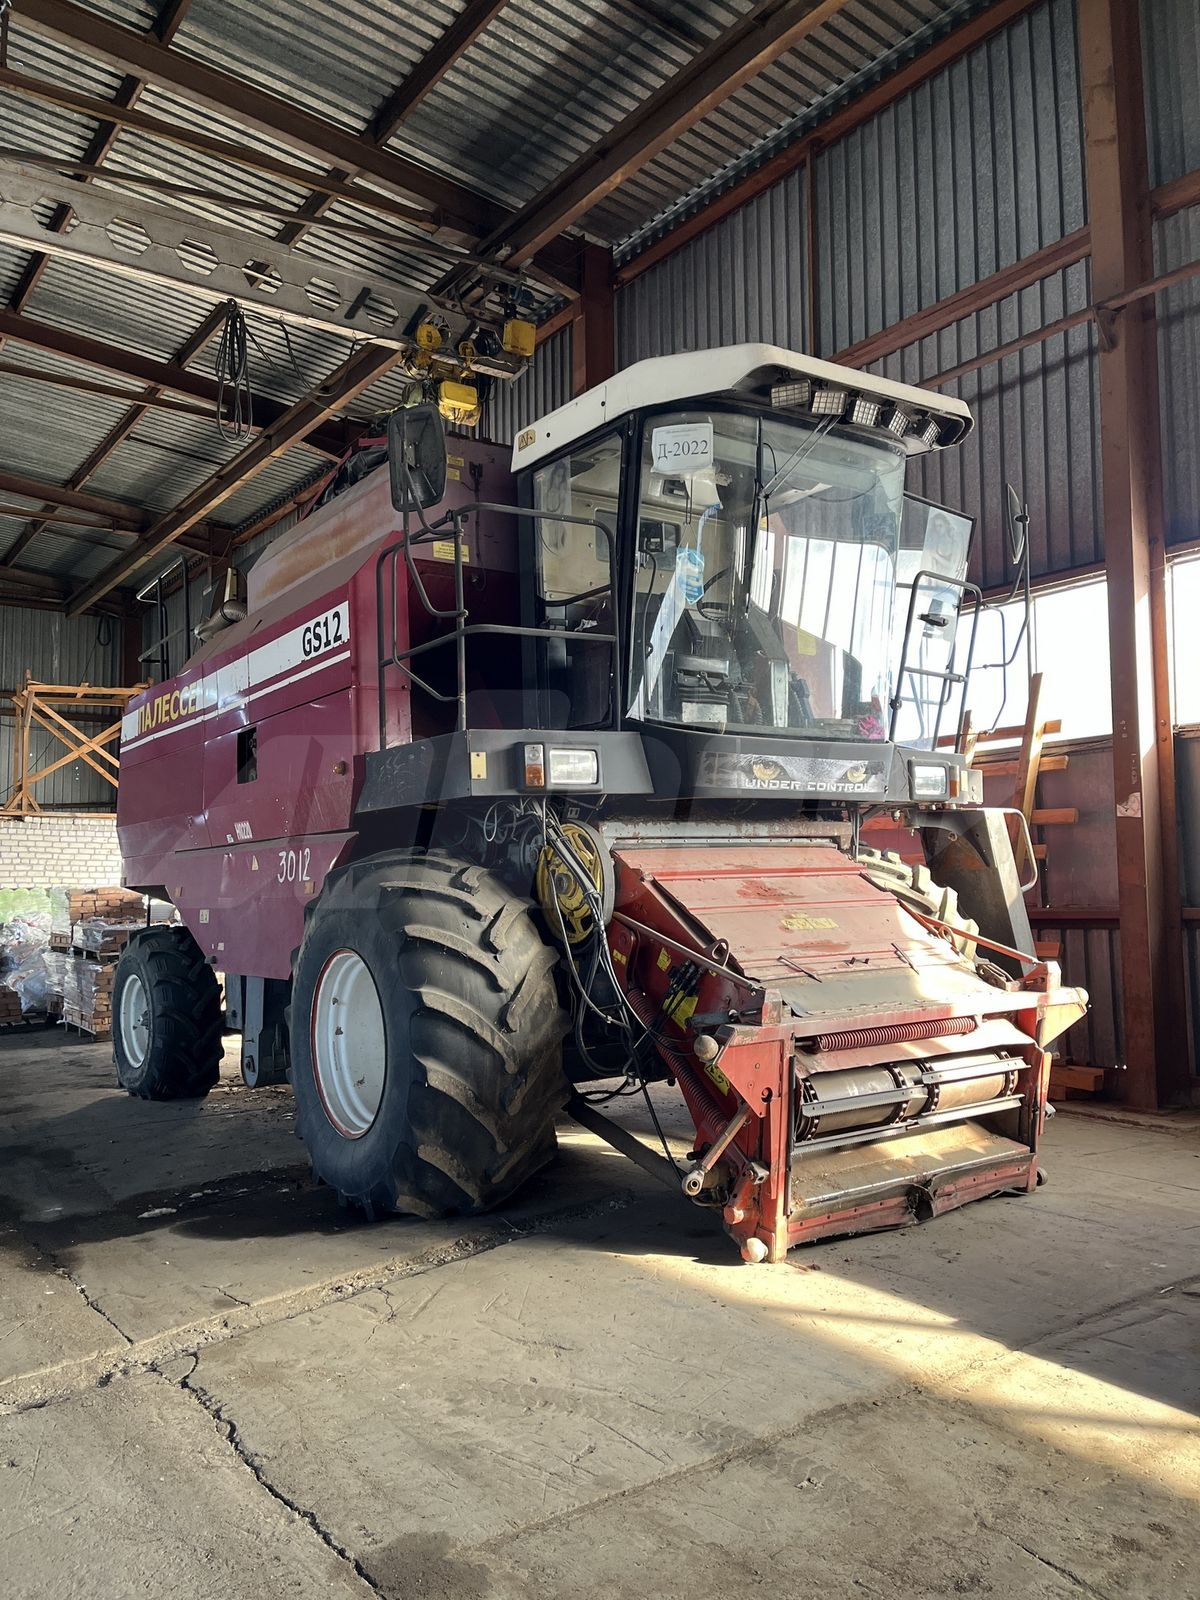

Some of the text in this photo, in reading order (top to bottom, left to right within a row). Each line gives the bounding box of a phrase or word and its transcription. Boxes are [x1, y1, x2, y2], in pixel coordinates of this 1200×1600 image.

[657, 439, 709, 461] Д-2022
[302, 610, 343, 657] GS12
[744, 778, 871, 793] UNDER CONTROL
[277, 848, 311, 883] 3012
